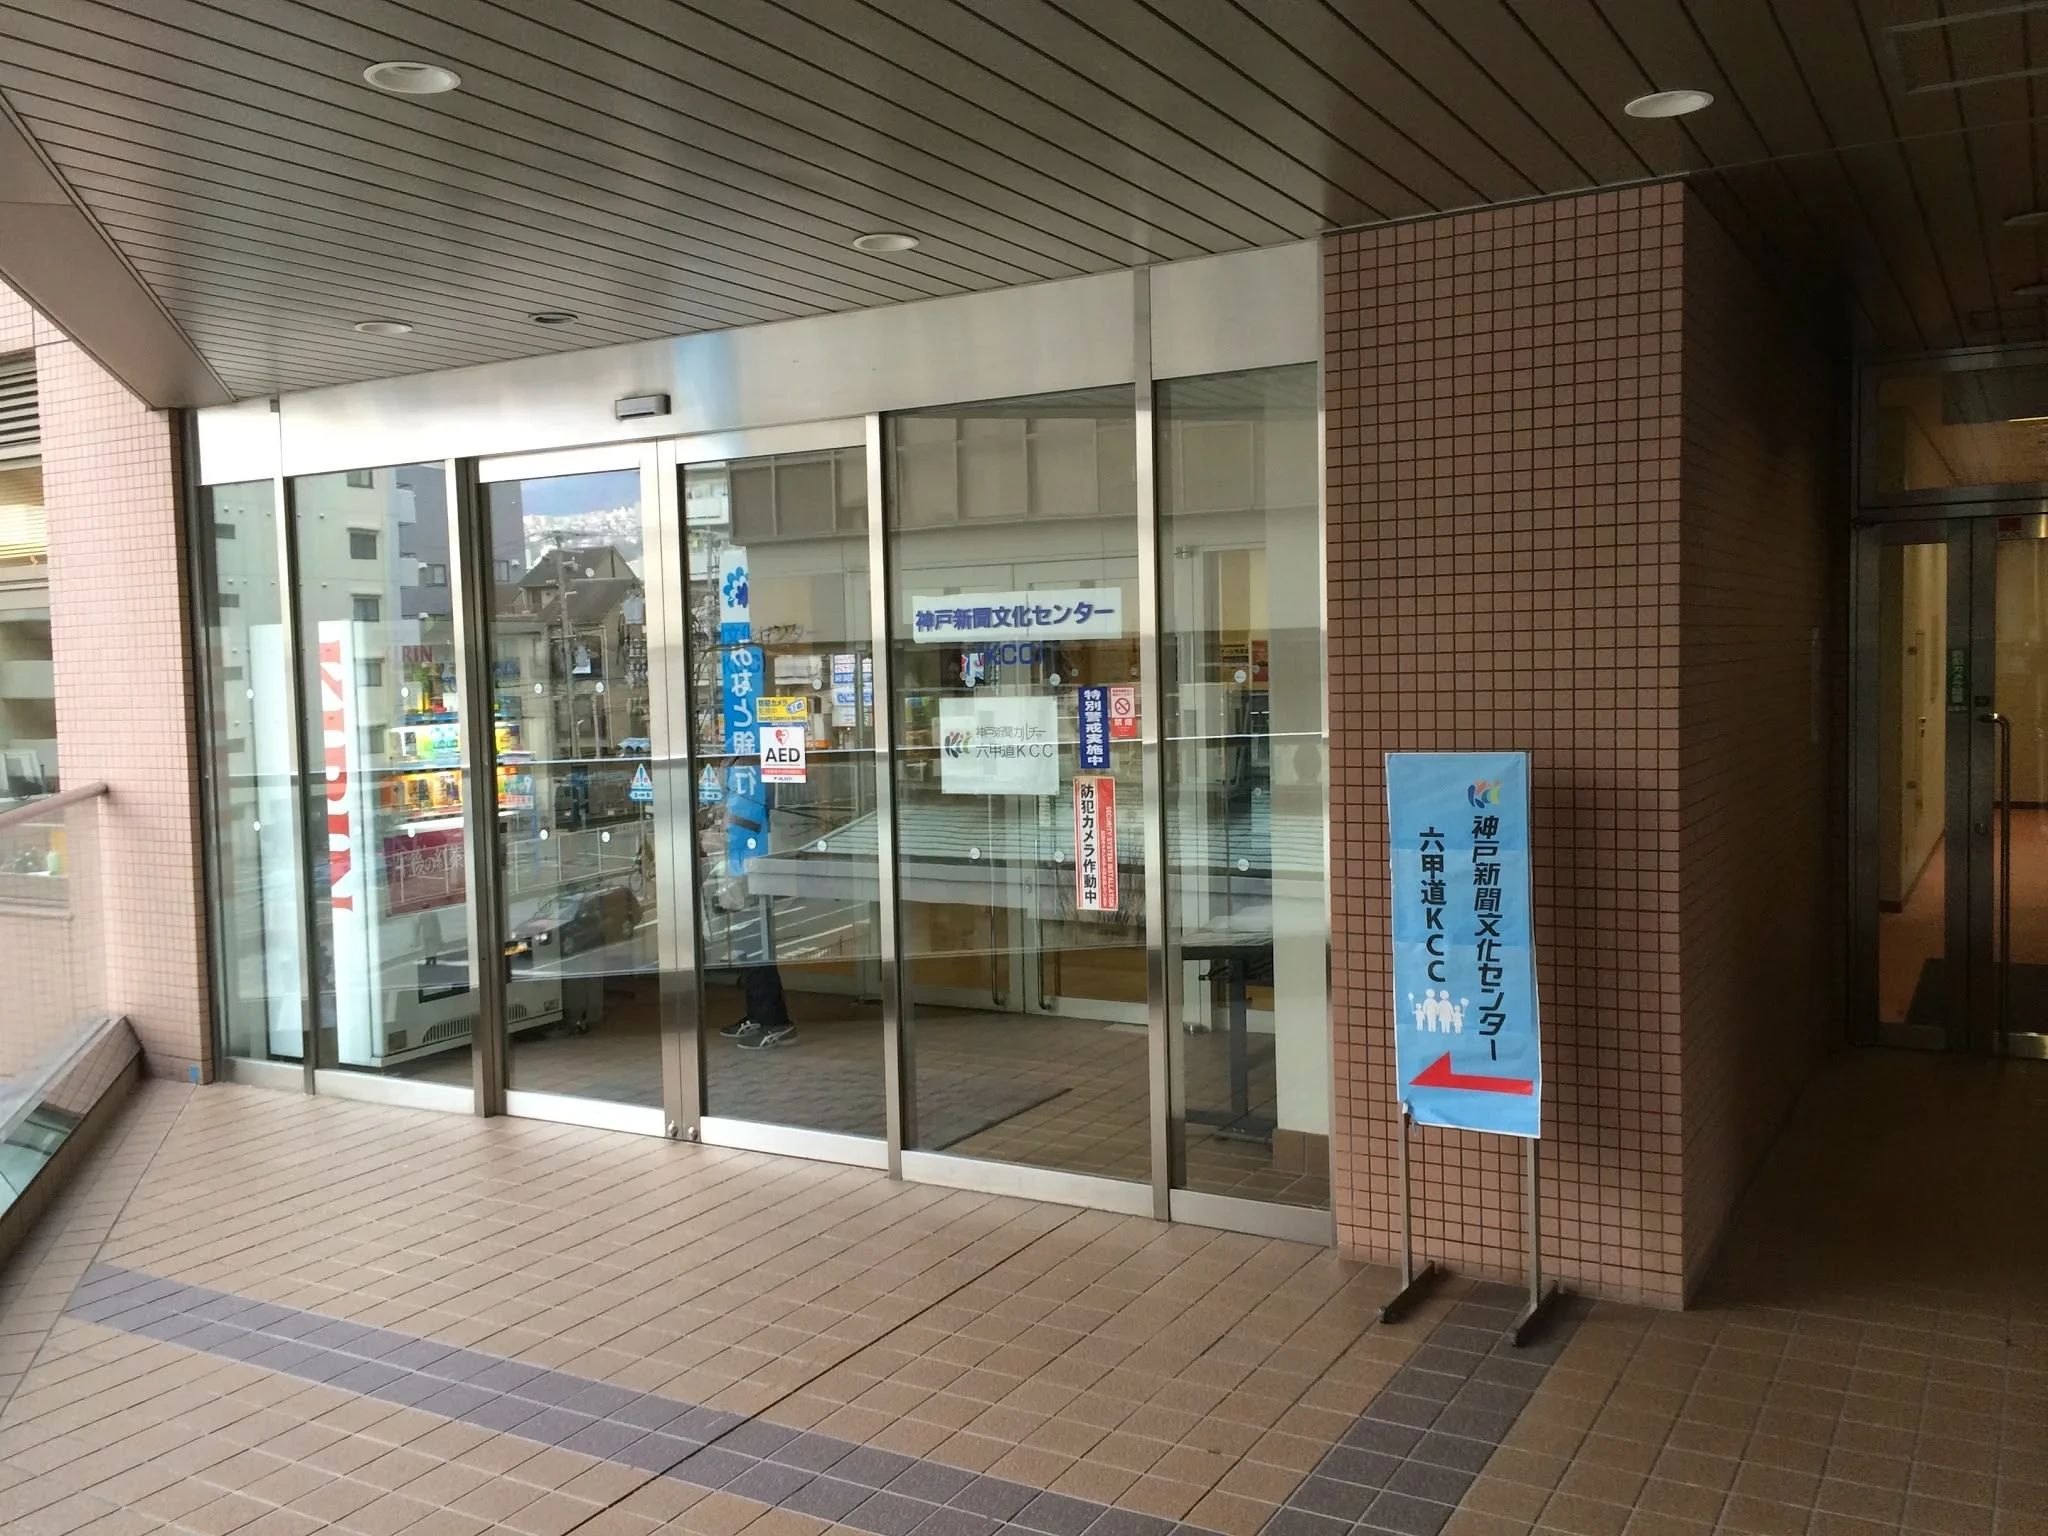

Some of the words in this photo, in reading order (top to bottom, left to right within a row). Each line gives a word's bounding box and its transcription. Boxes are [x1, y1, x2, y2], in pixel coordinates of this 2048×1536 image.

[916, 602, 1114, 632] 神戸新聞文化センター
[319, 640, 353, 912] KIRIN
[765, 747, 801, 762] AED
[1084, 689, 1103, 766] 特別警戒実施中
[1081, 784, 1097, 904] 防犯カメラ作動中
[1107, 863, 1115, 907] INSTALLATION
[1419, 826, 1446, 983] 六甲道KCC
[1471, 815, 1506, 1061] 神戸新聞文化センター
